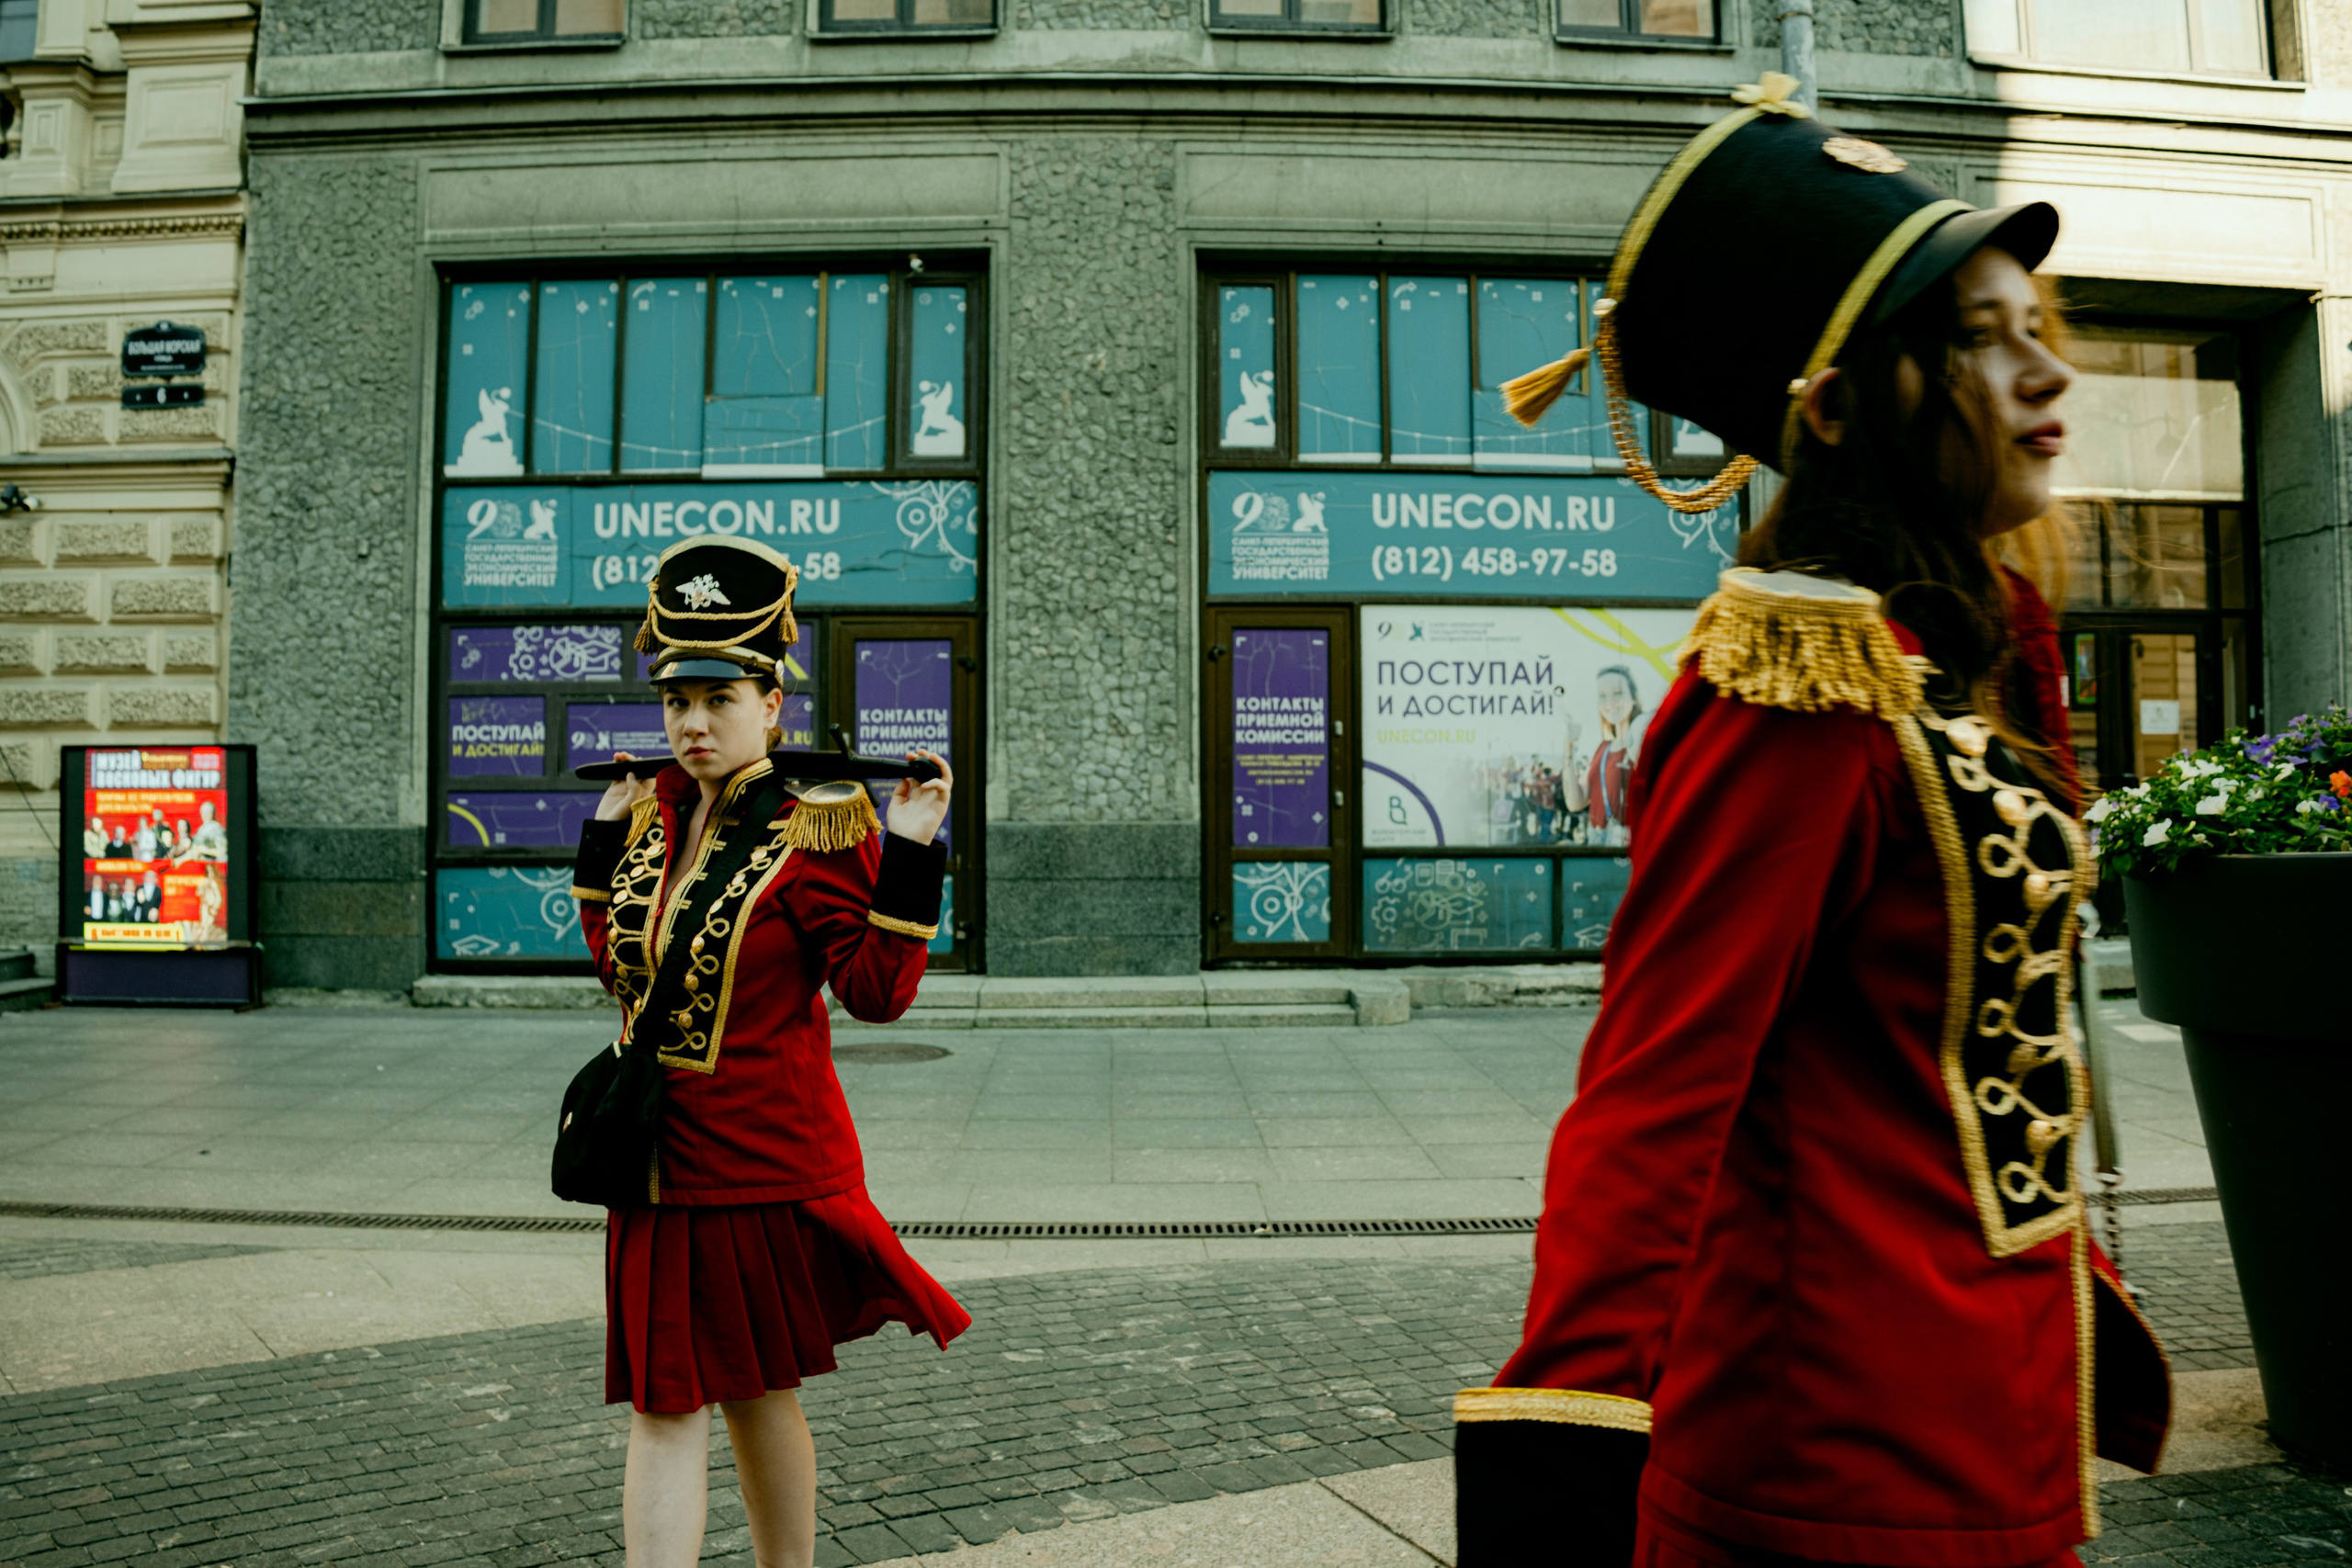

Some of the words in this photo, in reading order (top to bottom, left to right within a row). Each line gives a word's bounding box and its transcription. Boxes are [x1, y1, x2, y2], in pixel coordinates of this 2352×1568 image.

[157, 387, 166, 404] 6
[594, 499, 840, 537] UNECON.RU
[1372, 493, 1615, 531] UNECON.RU
[1372, 545, 1453, 581] (812)
[1461, 547, 1617, 577] 458-97-58
[464, 573, 556, 586] УНИВЕРСИТЕТ
[593, 555, 659, 591] (812
[1232, 567, 1328, 580] УНИВЕРСИТЕТ
[1378, 655, 1553, 685] ПОСТУПАЙ
[1236, 697, 1324, 711] КОНТАКТЫ
[1378, 695, 1394, 715] И
[1402, 691, 1554, 717] ДОСТИГАЙ!
[860, 709, 947, 724] КОНТАКТЫ
[1236, 710, 1324, 728] ПРИЕМНОЙ
[452, 721, 545, 741] ПОСТУПАЙ
[859, 723, 948, 739] ПРИЕМНОЙ
[1236, 729, 1325, 744] КОМИССИИ
[1378, 729, 1476, 744] UNECON.RU
[452, 743, 462, 756] И
[465, 741, 545, 758] ДОСТИГАЙ!
[859, 741, 948, 756] КОМИССИИ
